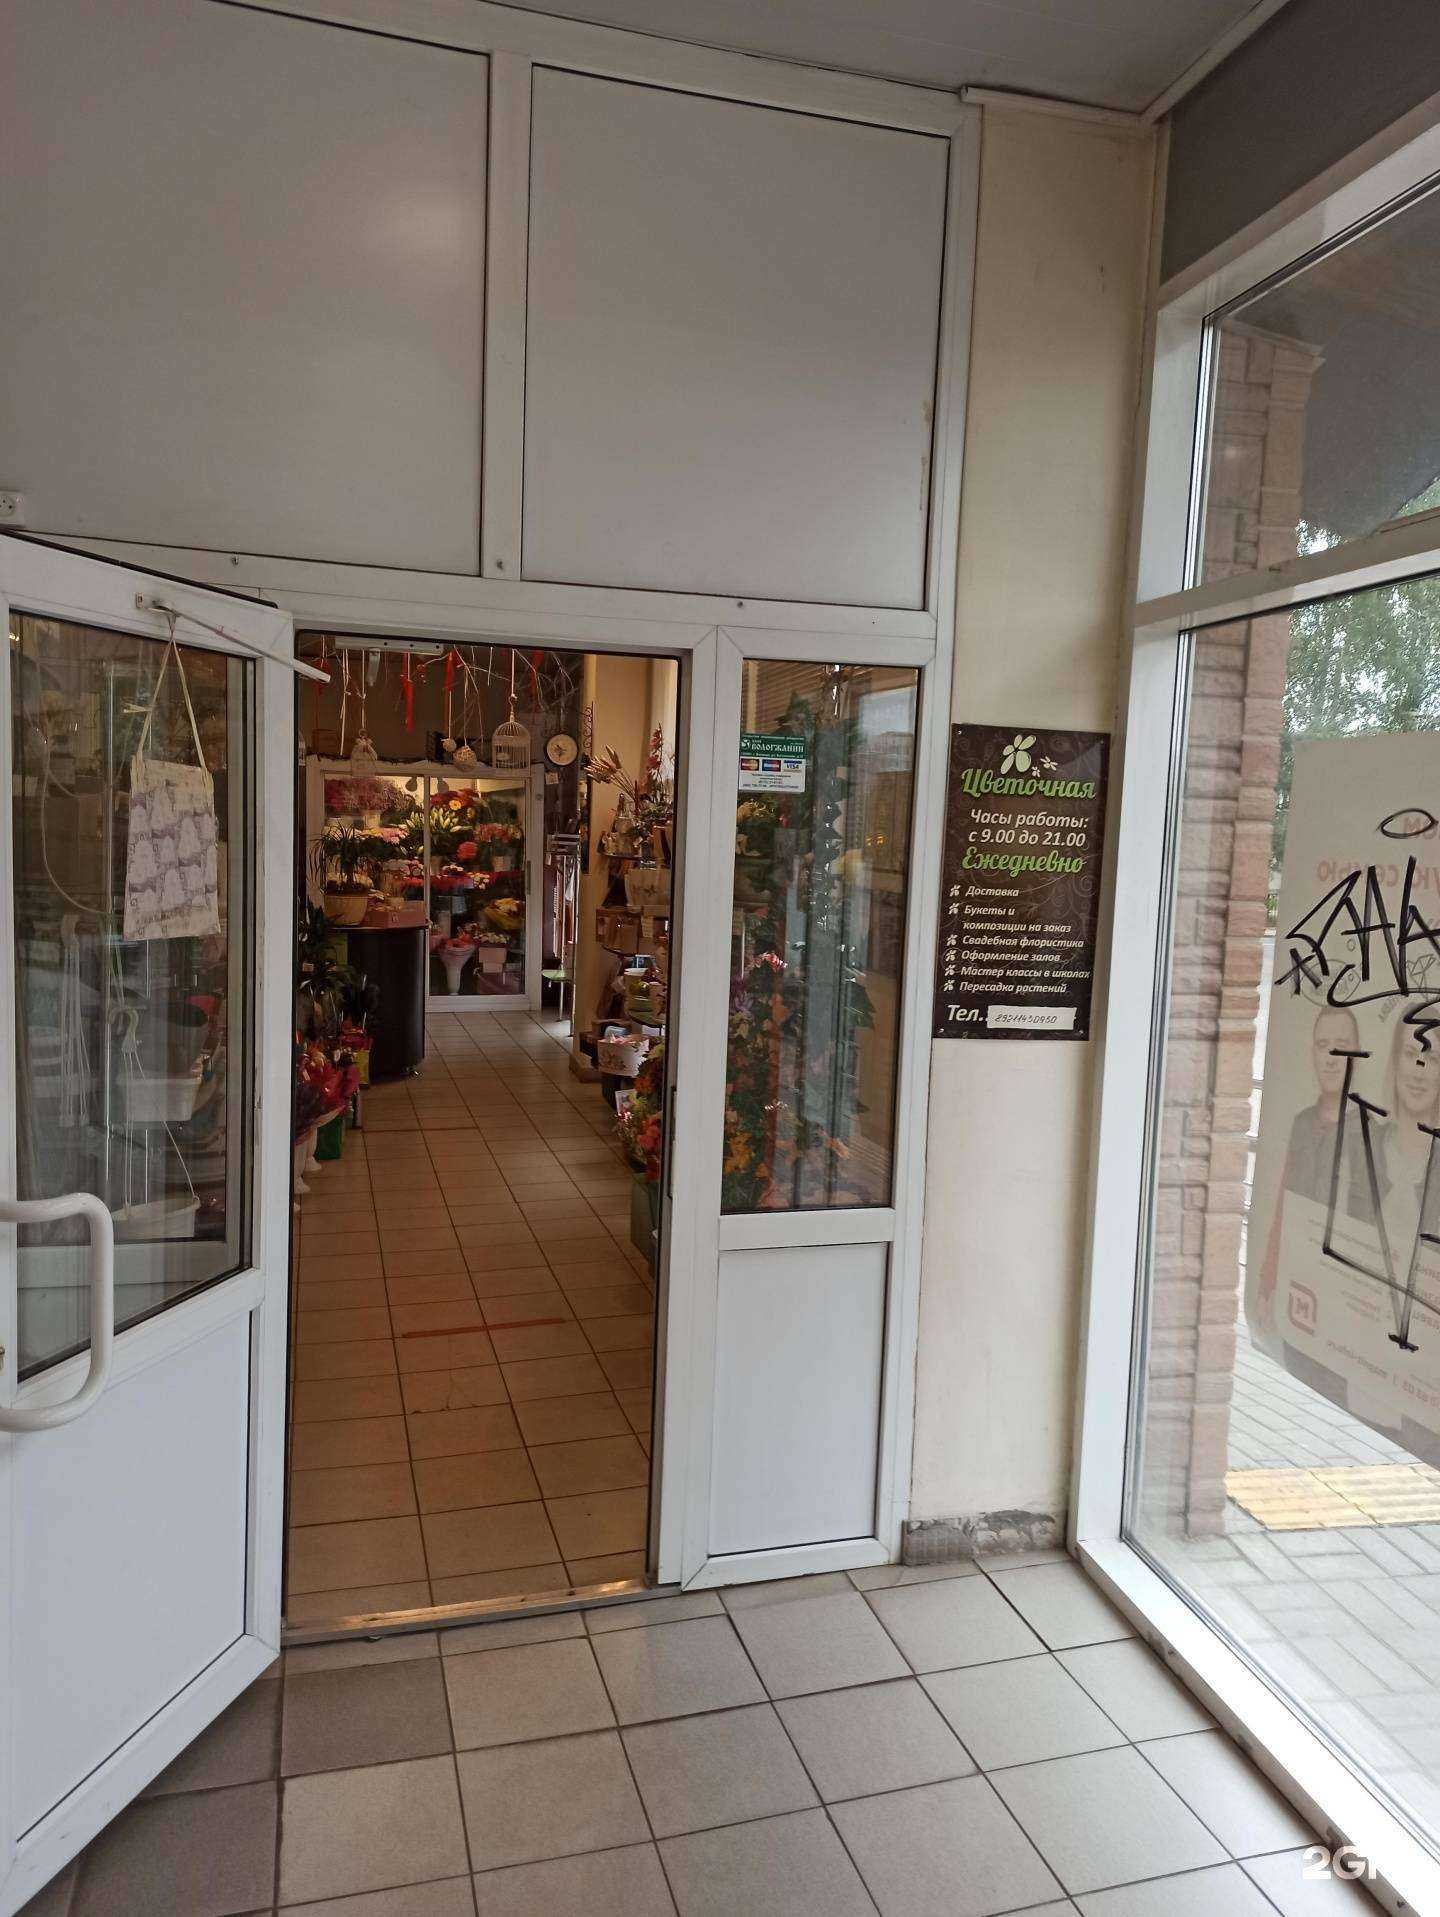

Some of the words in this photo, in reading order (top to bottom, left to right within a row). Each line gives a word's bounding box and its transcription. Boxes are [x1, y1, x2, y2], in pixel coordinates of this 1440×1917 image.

[962, 768, 1096, 799] Цветочная
[971, 808, 1012, 824] Часы
[1015, 812, 1089, 828] работы:
[968, 831, 978, 842] с
[980, 828, 1016, 844] 9.00
[1018, 830, 1039, 845] до
[1042, 831, 1086, 847] 21.00
[962, 846, 1087, 877] Ежедневно
[965, 885, 1020, 897] Доставка
[964, 905, 1006, 916] Букеты
[1008, 907, 1016, 916] и
[963, 922, 1027, 933] композиции
[1028, 924, 1042, 932] на
[1043, 925, 1072, 933] заказ
[962, 935, 1018, 947] Свадебная
[1019, 936, 1084, 949] флористика
[961, 951, 1029, 964] Оформление
[1031, 954, 1061, 962] залов
[960, 967, 1004, 980] Мастер
[1005, 968, 1042, 978] классы
[1043, 970, 1050, 978] в
[1051, 970, 1090, 980] школах
[959, 982, 1015, 995] Пересадка
[1016, 983, 1068, 995] растений
[947, 1004, 984, 1022] Тел.
